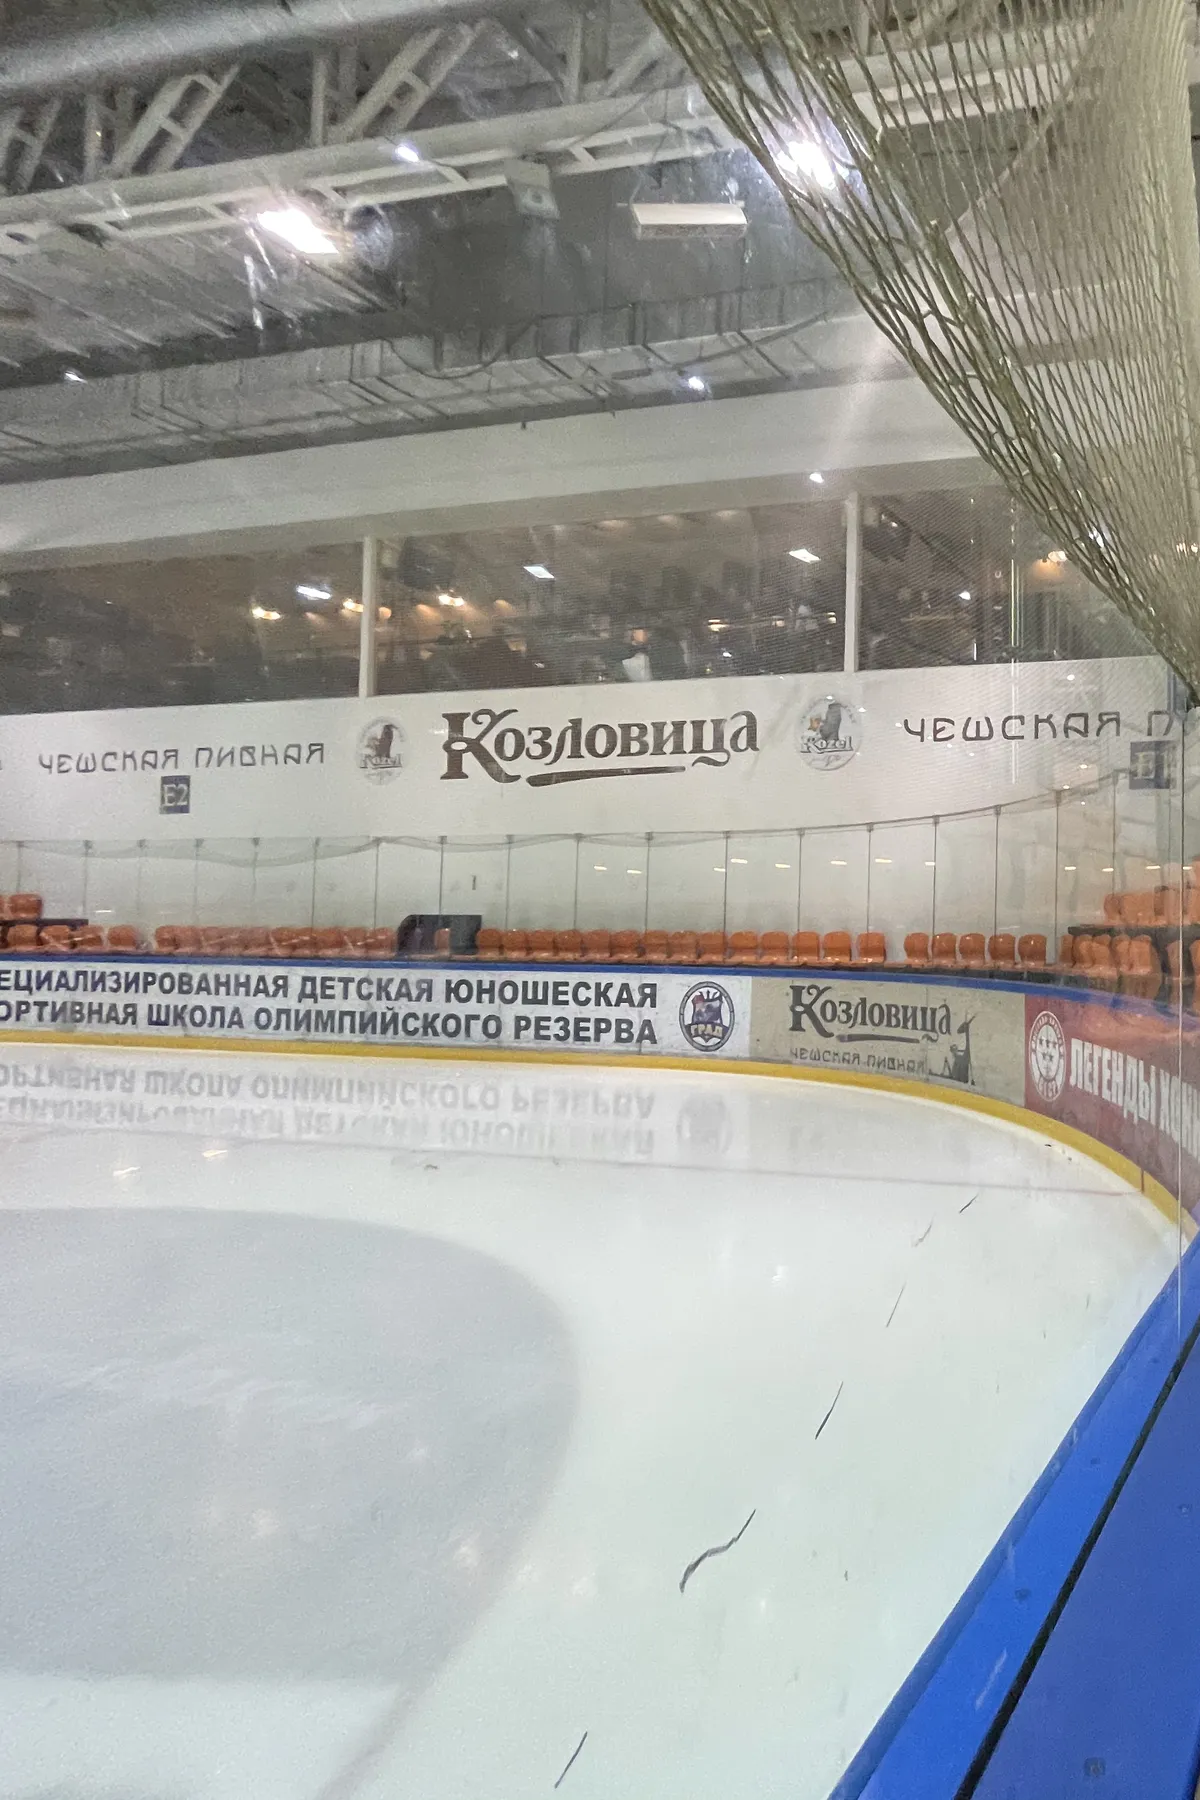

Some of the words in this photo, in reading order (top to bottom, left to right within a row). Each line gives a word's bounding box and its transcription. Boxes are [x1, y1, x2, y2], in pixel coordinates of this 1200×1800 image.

[903, 710, 1121, 743] ЧЕШСКАЯ
[38, 748, 179, 775] ЧЕШСКАЯ
[194, 742, 325, 769] ПИВНАЯ
[439, 708, 761, 784] Козловица
[800, 736, 854, 754] Kozel
[162, 783, 190, 808] E2
[298, 975, 433, 1003] ДЕТСКАЯ
[444, 978, 658, 1009] ЮНОШЕСКАЯ
[147, 1003, 245, 1029] ШКОЛА
[253, 1006, 502, 1039] ОЛИМПИЙСКОГО
[513, 1014, 658, 1045] РЕЗЕРВА
[788, 984, 953, 1042] Козловица
[690, 1023, 724, 1037] ГРАД
[790, 1047, 860, 1066] ЧЕШСКАЯ
[866, 1054, 927, 1074] ПИВНАЯ
[1069, 1038, 1157, 1126] ЛЕГЕНДЫ
